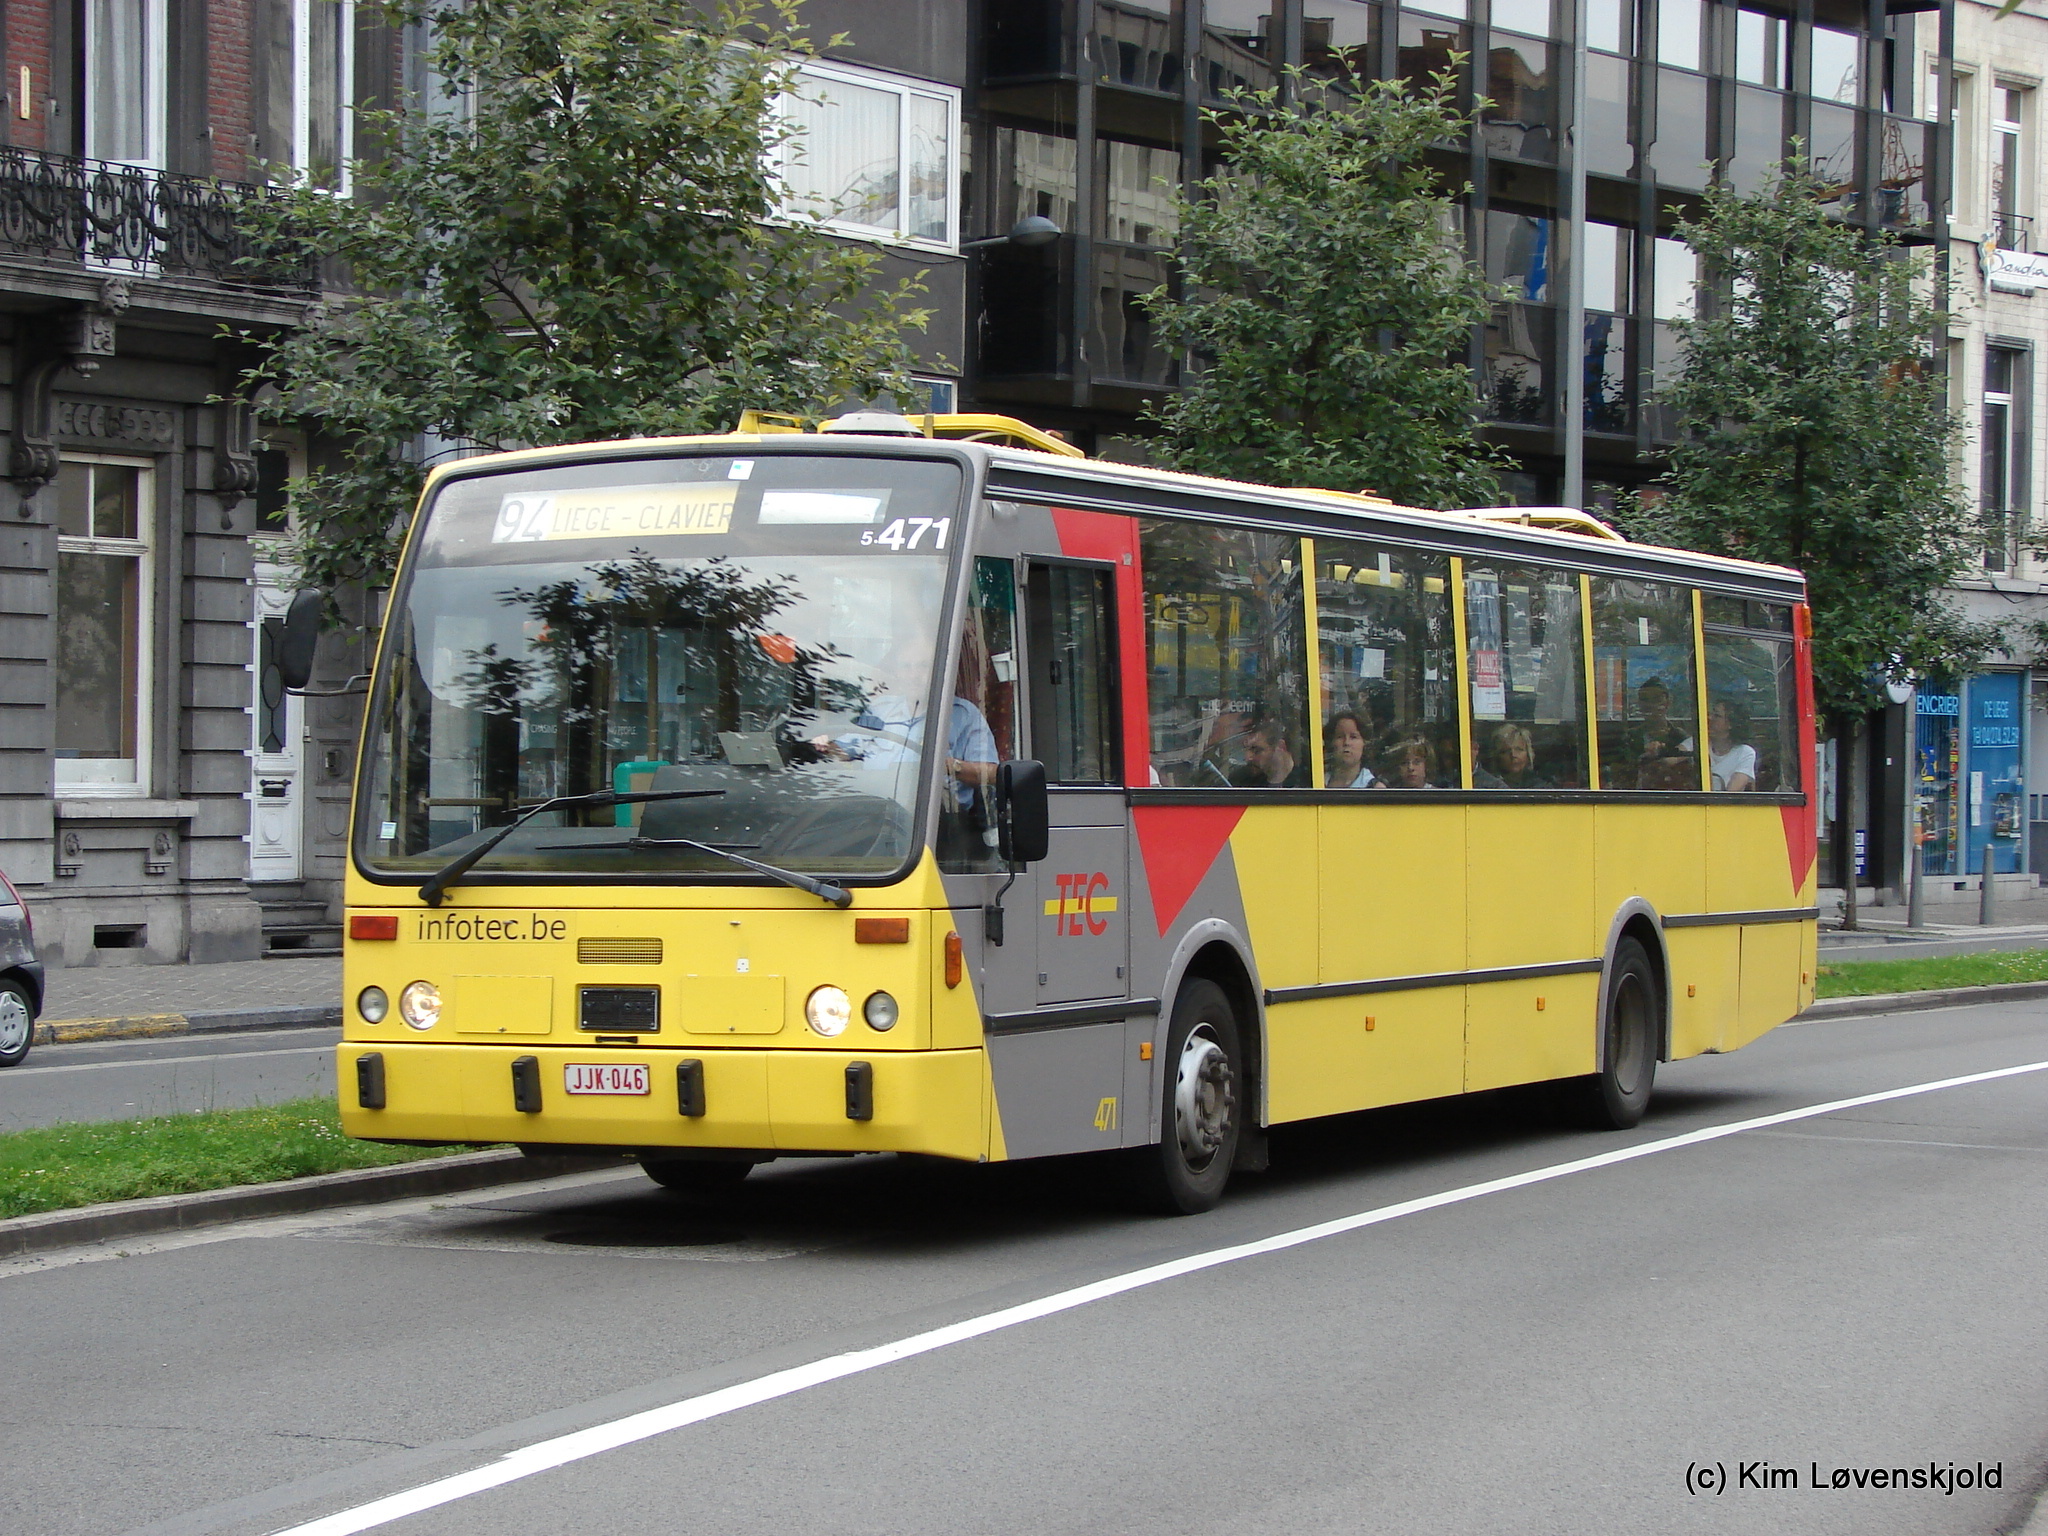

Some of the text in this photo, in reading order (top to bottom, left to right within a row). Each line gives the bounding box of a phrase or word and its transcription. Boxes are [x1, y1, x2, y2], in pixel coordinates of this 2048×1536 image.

[501, 500, 548, 541] 94
[552, 507, 616, 532] LIEGE
[638, 503, 733, 530] CLAVIER
[1916, 695, 1958, 713] ENCRIER
[1055, 872, 1109, 937] TEC
[418, 913, 567, 940] infotec.be
[1093, 1097, 1117, 1131] 471
